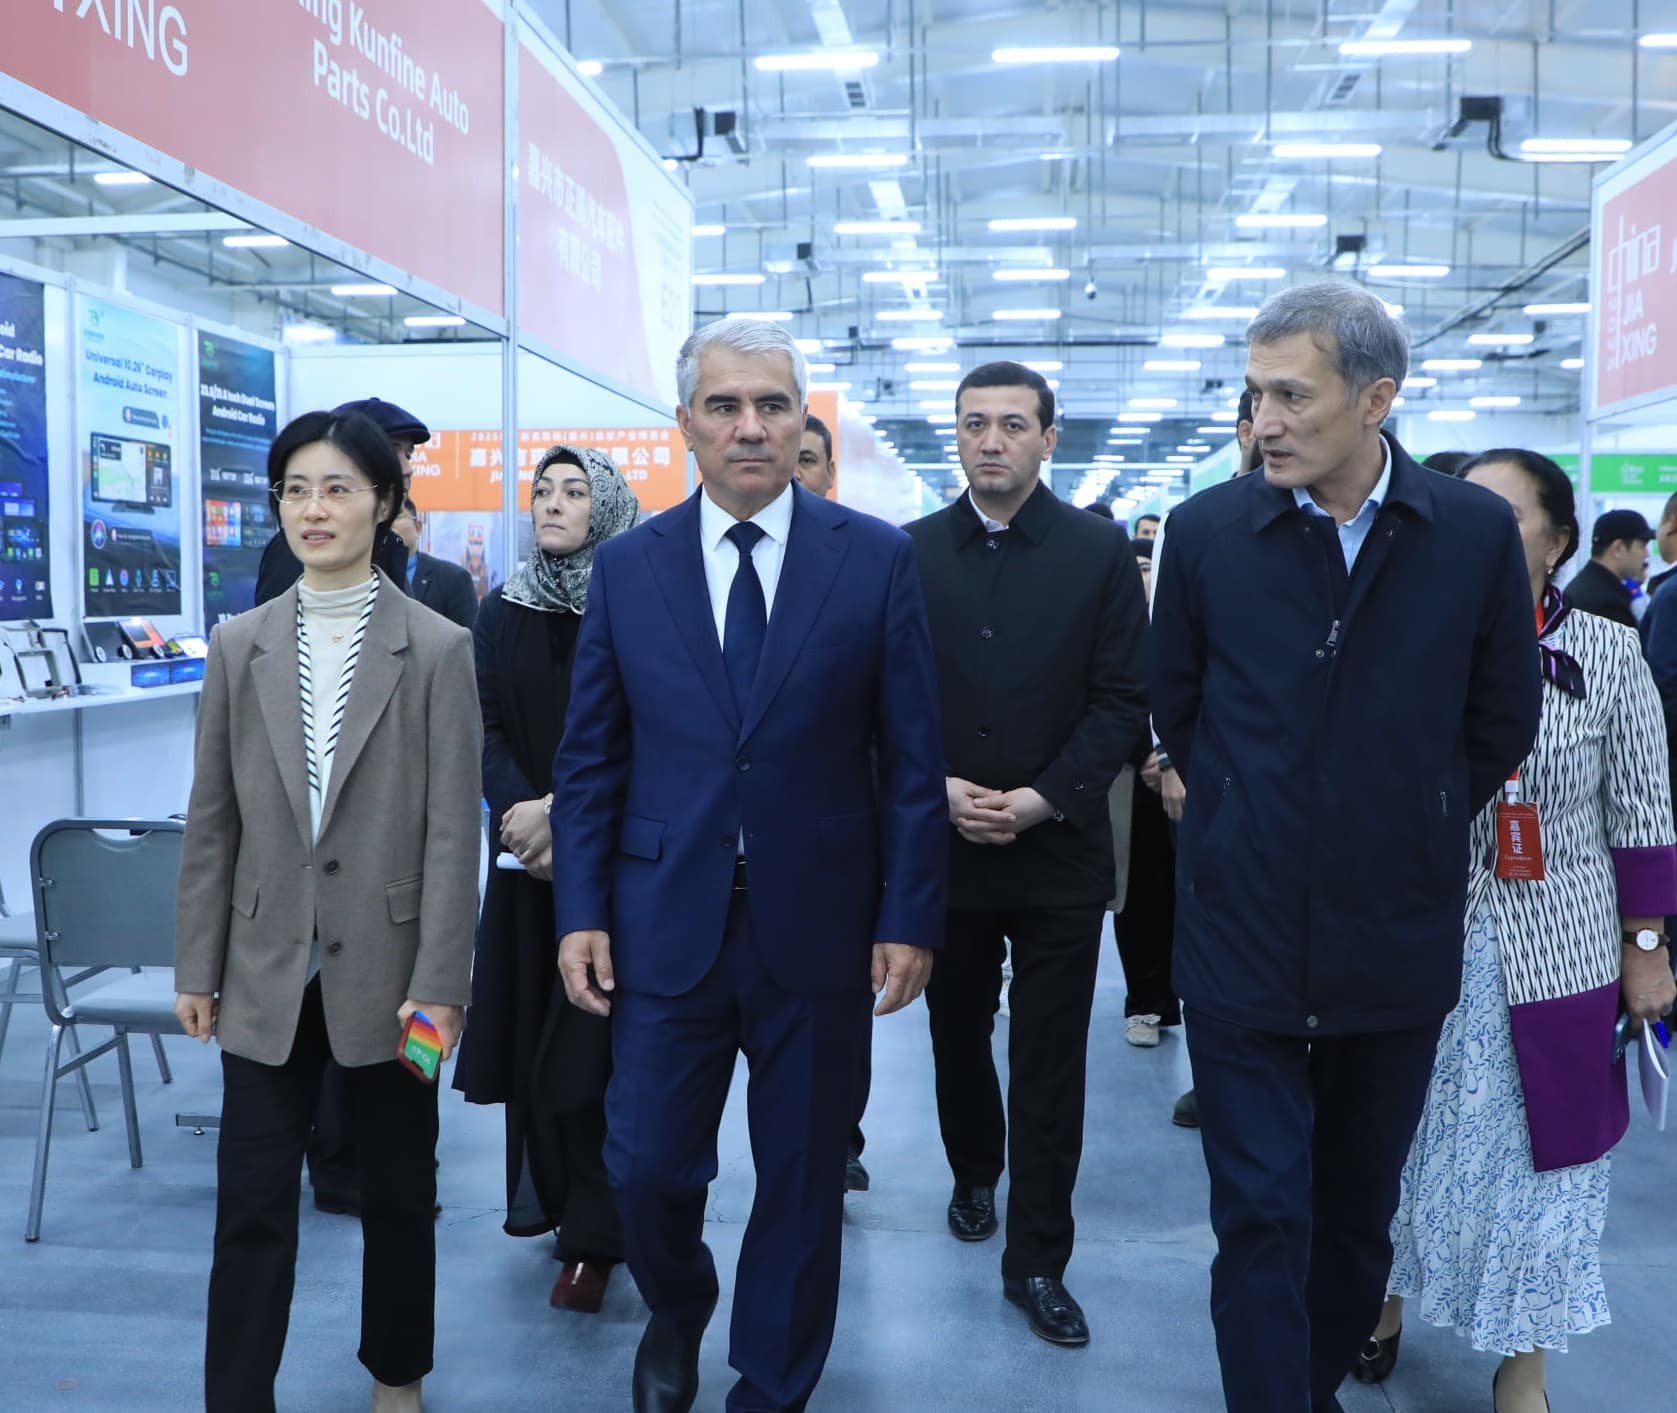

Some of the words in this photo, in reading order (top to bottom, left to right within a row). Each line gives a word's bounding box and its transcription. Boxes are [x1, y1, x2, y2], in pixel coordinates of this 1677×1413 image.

[350, 2, 425, 101] Kunfine
[429, 71, 469, 135] Auto
[313, 38, 370, 120] Parts
[375, 87, 434, 165] Co.Ltd
[16, 347, 43, 366] Radio
[86, 350, 122, 368] Universal
[1621, 322, 1657, 366] XING
[93, 372, 124, 389] Android
[126, 379, 143, 393] Auto
[144, 384, 168, 398] Screen
